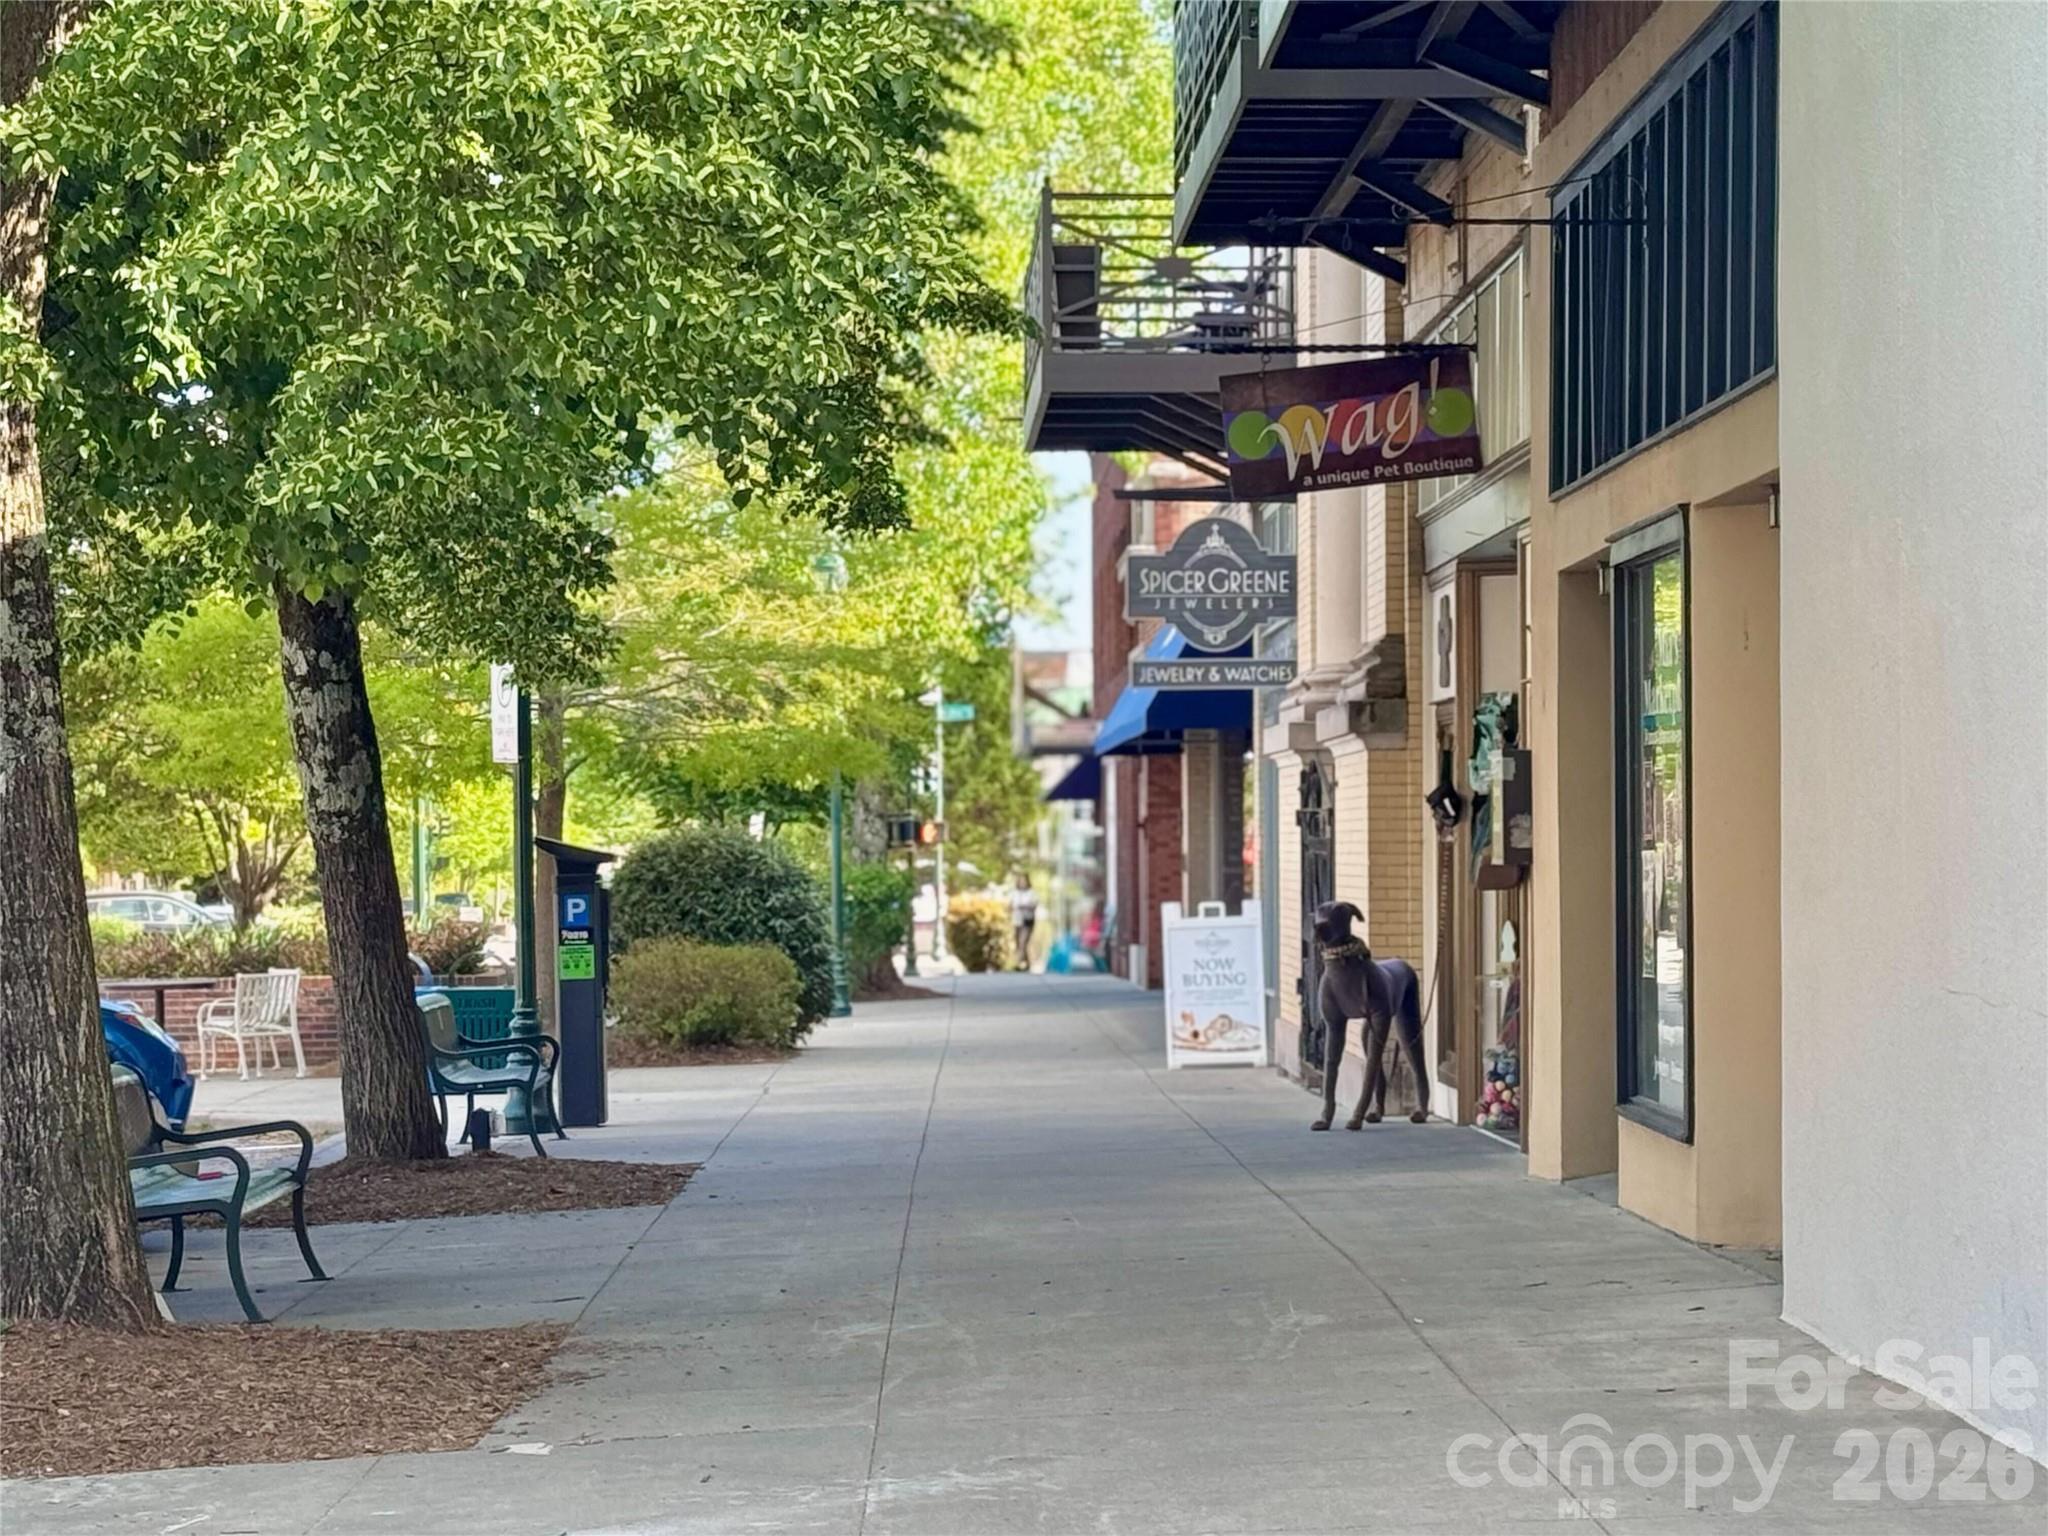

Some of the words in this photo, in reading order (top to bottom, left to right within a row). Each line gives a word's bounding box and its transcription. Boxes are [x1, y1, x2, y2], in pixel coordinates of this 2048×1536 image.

[1257, 357, 1440, 482] Wag!
[1303, 475, 1313, 487] a
[1316, 466, 1370, 487] unique
[1374, 463, 1400, 478] Pet
[1404, 456, 1474, 475] Boutique
[1139, 568, 1206, 594] SPICER
[1208, 568, 1290, 594] GREENE
[1154, 598, 1274, 609] JEWELERS
[1139, 667, 1205, 684] JEWELRY
[1208, 666, 1221, 683] &
[1224, 666, 1293, 682] WATCHES
[567, 898, 586, 922] P
[1193, 957, 1236, 972] NOW
[1182, 973, 1248, 987] BUYING
